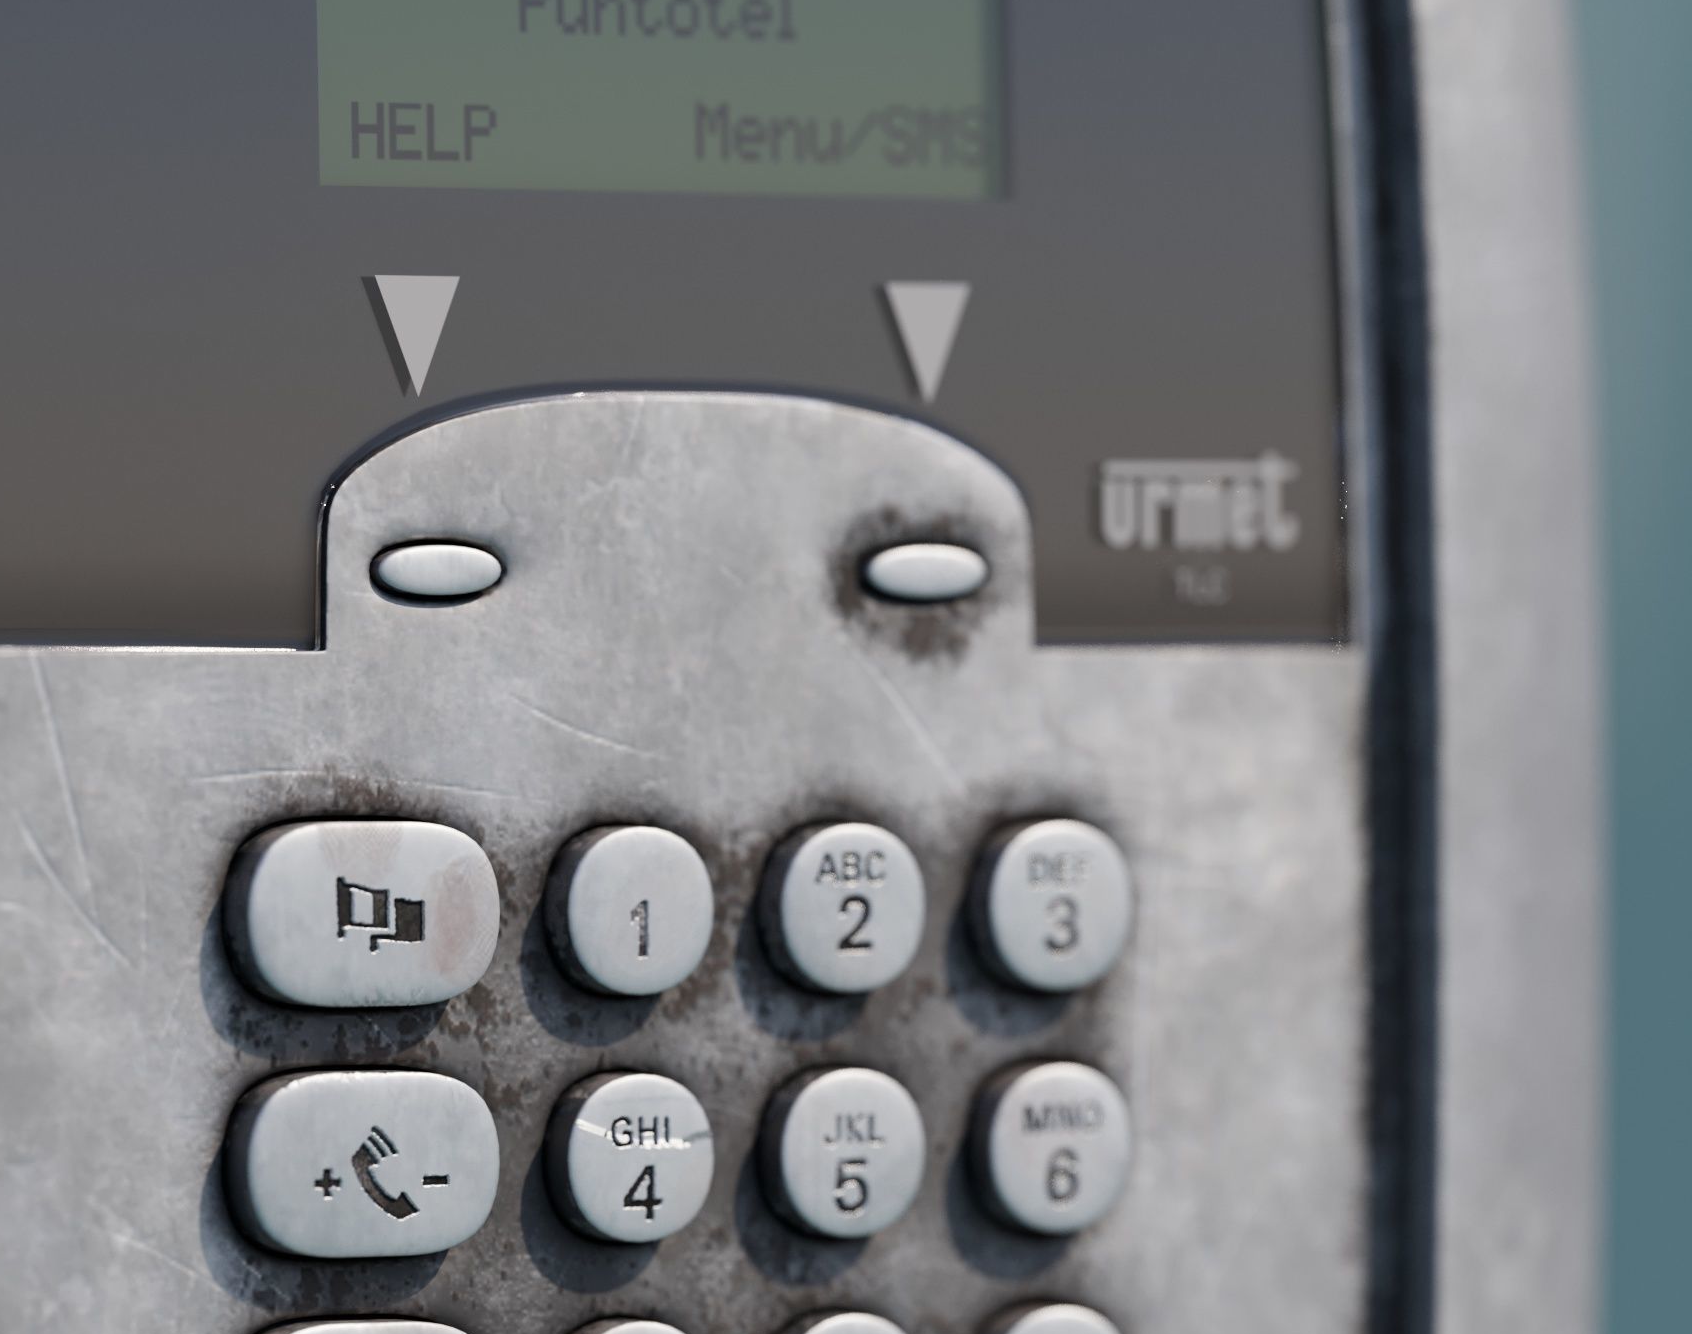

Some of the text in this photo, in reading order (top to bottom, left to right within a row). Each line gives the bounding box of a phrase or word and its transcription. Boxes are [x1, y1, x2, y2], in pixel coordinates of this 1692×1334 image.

[351, 101, 498, 164] HELP
[693, 100, 987, 171] Menu/SMS
[815, 851, 888, 887] ABC
[629, 898, 651, 958] 1
[836, 893, 874, 953] 2
[1044, 893, 1080, 953] 3
[610, 1115, 672, 1148] GHI
[823, 1112, 885, 1149] JKL
[622, 1165, 664, 1221] 4
[833, 1158, 870, 1217] 5
[1044, 1145, 1080, 1207] 6
